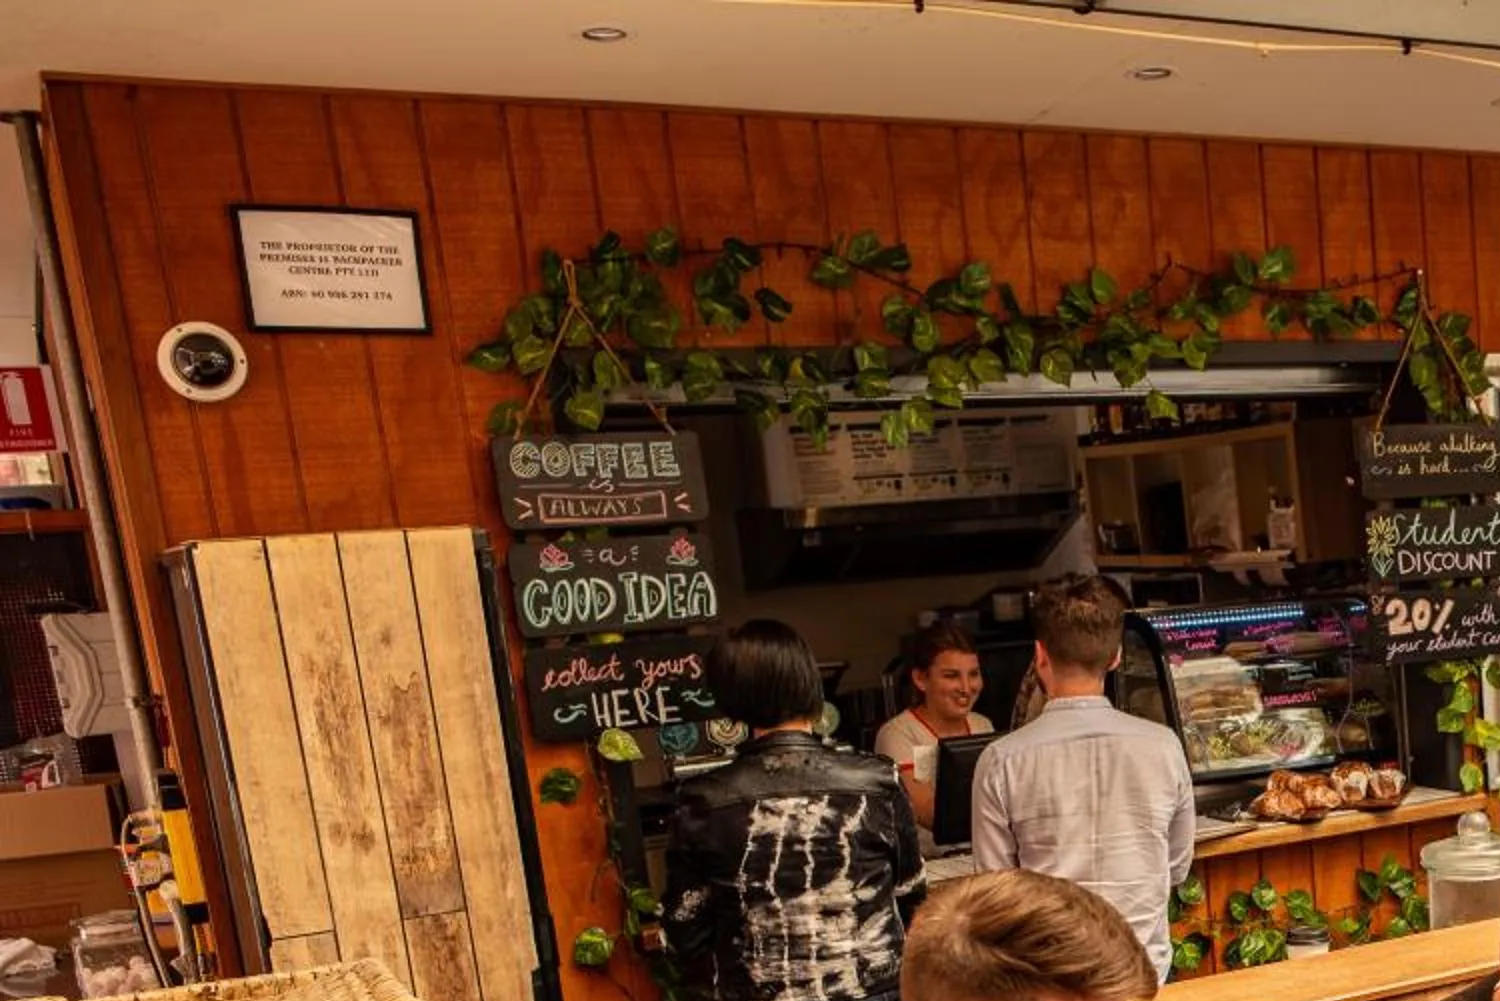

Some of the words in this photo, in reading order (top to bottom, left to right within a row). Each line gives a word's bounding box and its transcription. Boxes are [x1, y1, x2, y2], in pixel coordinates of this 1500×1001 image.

[259, 241, 283, 250] THE
[286, 242, 358, 253] PROPRIETOR
[360, 244, 375, 253] OF
[377, 245, 400, 255] THE
[1373, 431, 1433, 458] Because
[509, 441, 681, 479] COFFEE
[1397, 459, 1412, 475] is
[588, 479, 615, 493] is
[550, 498, 642, 517] ALWAYS
[599, 547, 627, 566] a
[1397, 549, 1497, 576] DISCOUNT
[523, 577, 618, 629] GOOD
[618, 570, 718, 624] IDEA
[1384, 598, 1455, 637] 20%
[1461, 602, 1499, 627] with
[1385, 639, 1424, 666] your
[1426, 627, 1482, 652] student
[541, 651, 625, 692] collect
[635, 653, 702, 689] yours
[591, 685, 683, 728] HERE
